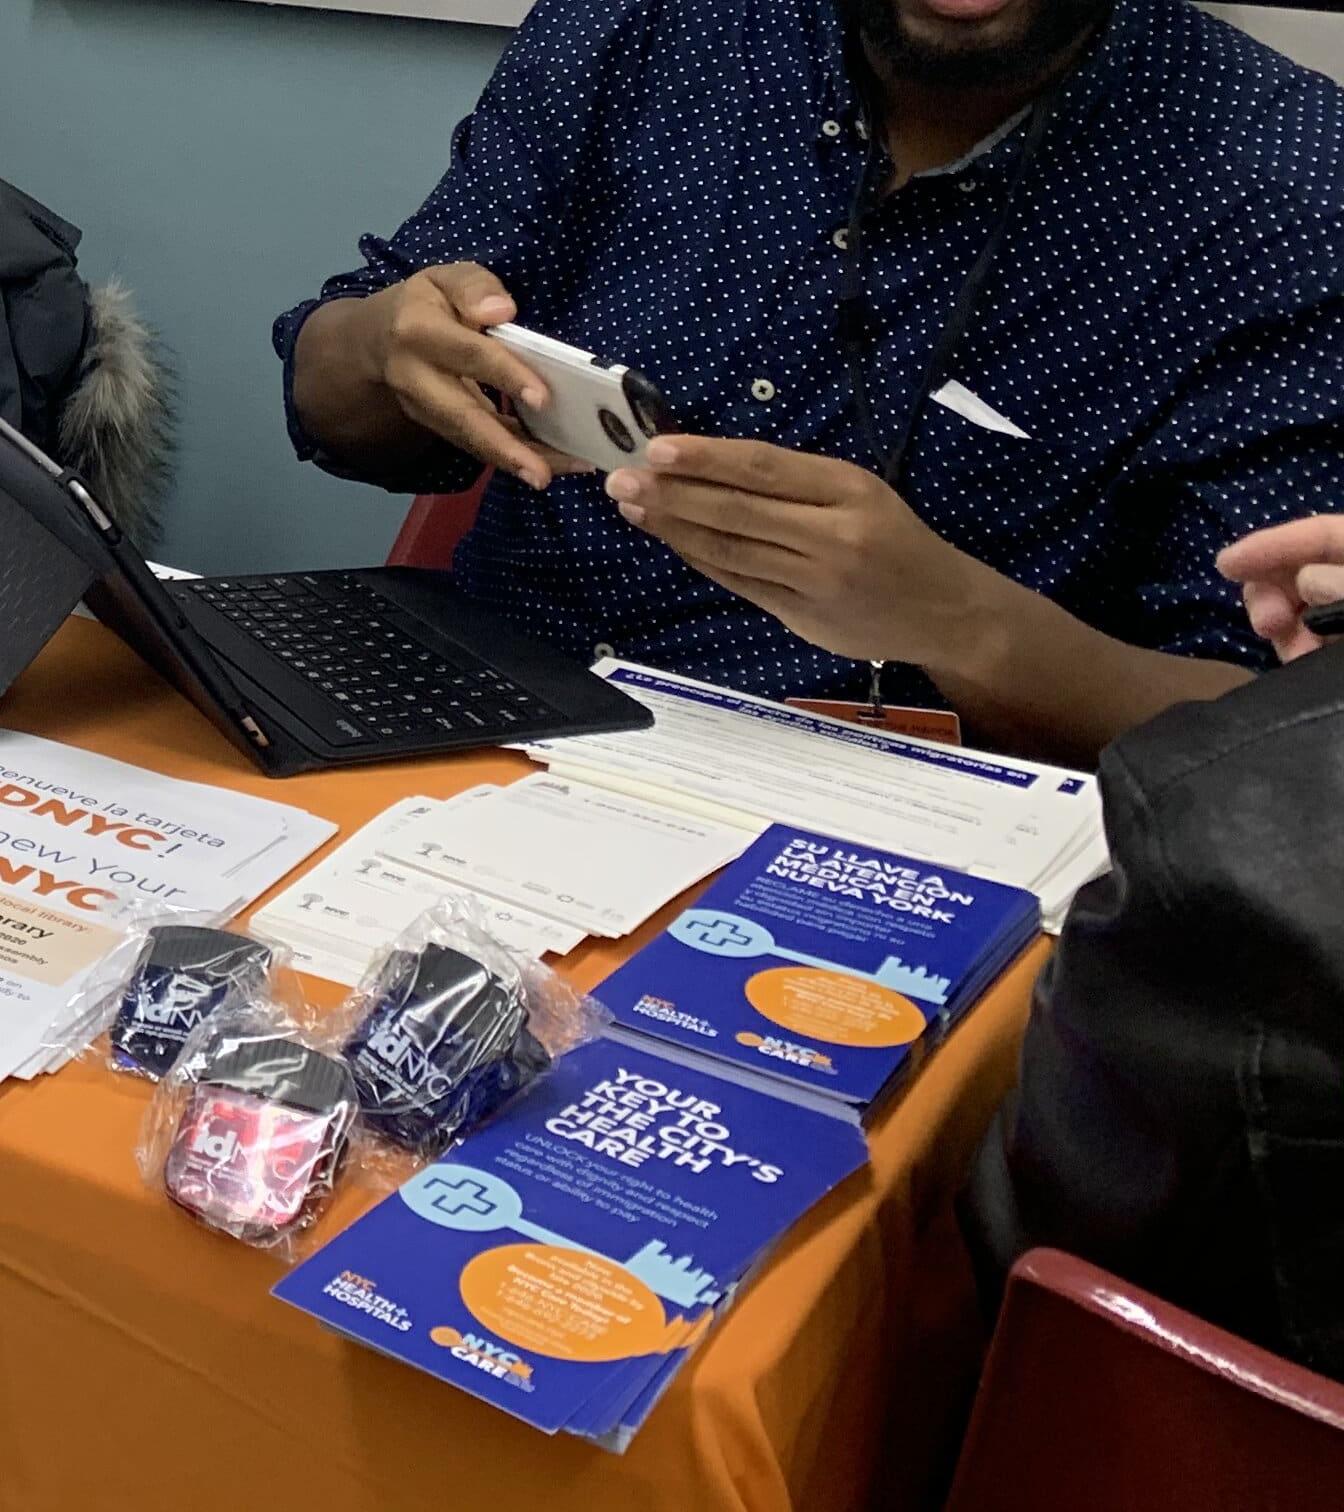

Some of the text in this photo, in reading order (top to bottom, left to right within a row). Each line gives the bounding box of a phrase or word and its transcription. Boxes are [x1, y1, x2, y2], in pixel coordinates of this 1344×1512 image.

[102, 801, 129, 817] la
[135, 812, 227, 849] tarjeta
[88, 857, 187, 899] Your
[789, 838, 944, 887] SU LLAVE A
[0, 895, 36, 914] local
[766, 864, 864, 900] NUEVA
[871, 892, 956, 925] YORK
[632, 1006, 718, 1038] HOSPITALS
[757, 1045, 812, 1066] CARE
[593, 1080, 730, 1140] KEY TO
[615, 1067, 722, 1121] YOUR
[544, 1118, 650, 1168] CARE
[558, 1104, 712, 1175] HEALTH
[580, 1091, 784, 1184] THE CITY'S
[514, 1140, 710, 1229] care with dignity and respect
[524, 1132, 719, 1221] UNLOCK your right to health
[323, 1284, 412, 1333] HOSPITALS
[450, 1345, 510, 1379] CARE
[461, 1332, 522, 1365] NYC
